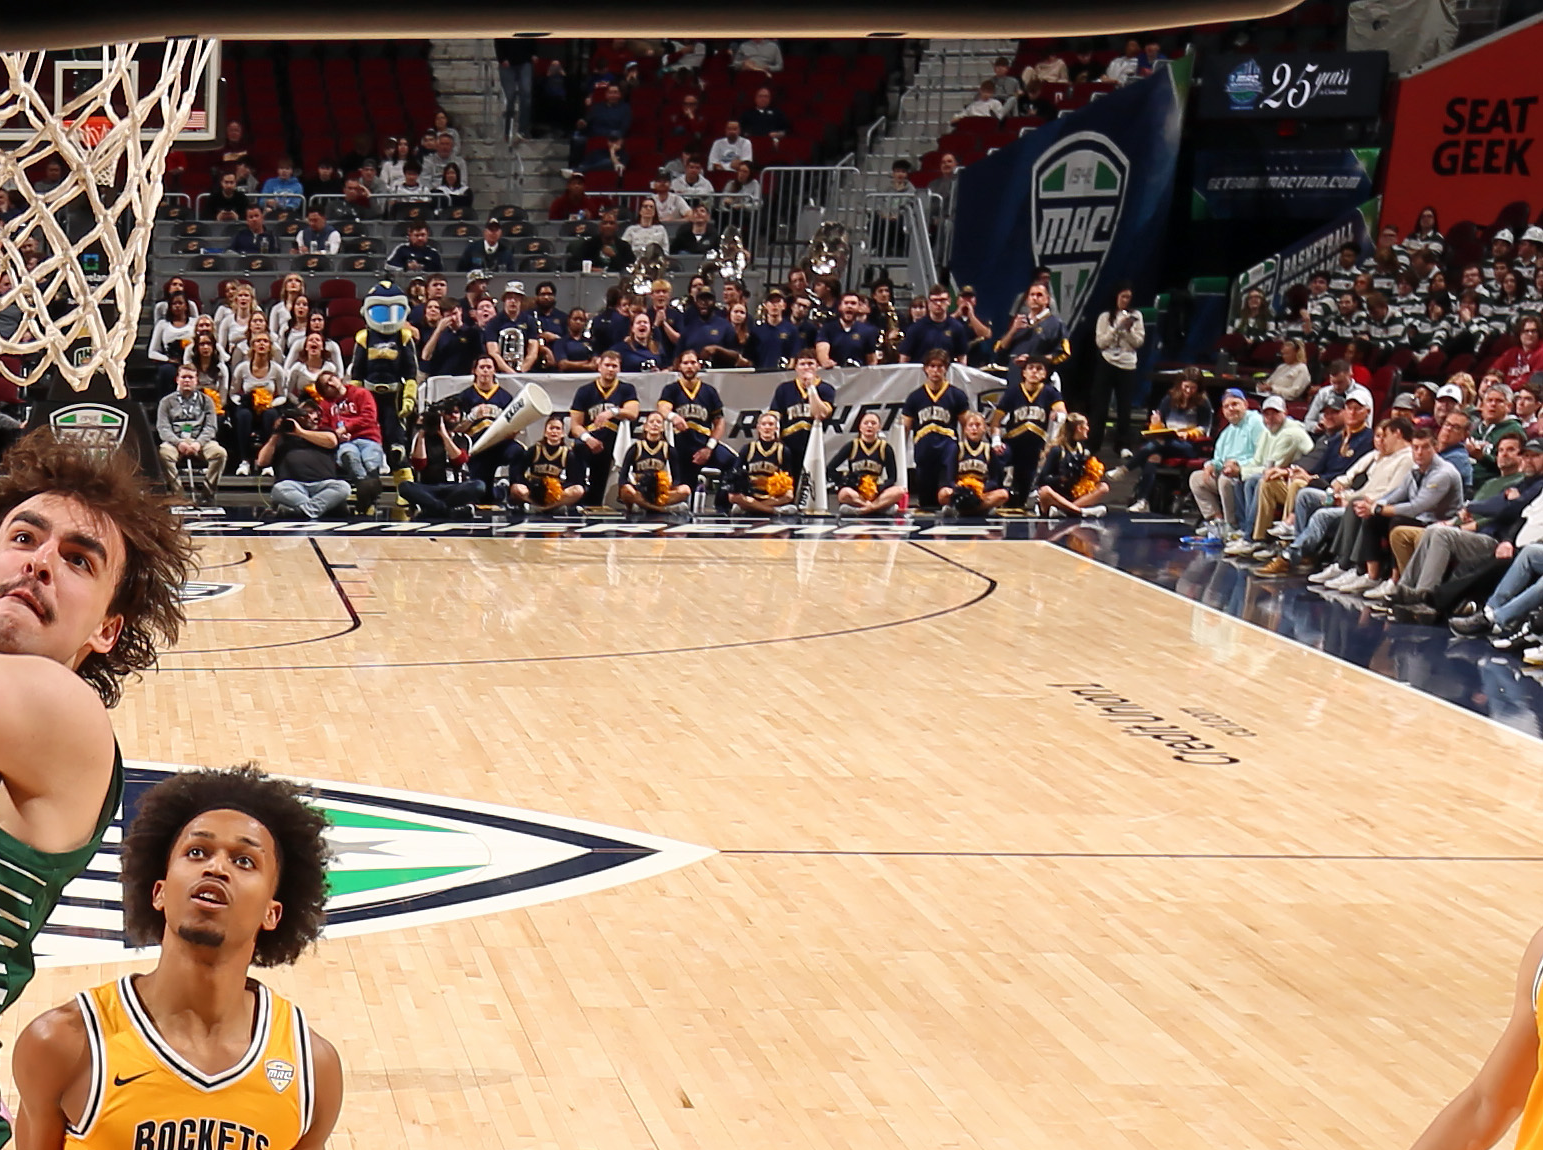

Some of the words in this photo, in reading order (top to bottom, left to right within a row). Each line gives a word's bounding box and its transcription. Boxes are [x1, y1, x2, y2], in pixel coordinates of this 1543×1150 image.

[1259, 63, 1319, 109] 25
[1310, 68, 1352, 99] years
[1443, 96, 1539, 135] SEAT
[1432, 138, 1534, 177] GEEK
[1037, 206, 1115, 256] MAC
[918, 406, 951, 424] TOLEDO
[1014, 405, 1046, 423] TOLEDO
[1071, 690, 1165, 723] Union
[1122, 725, 1240, 765] Credit
[268, 1070, 293, 1080] MAC
